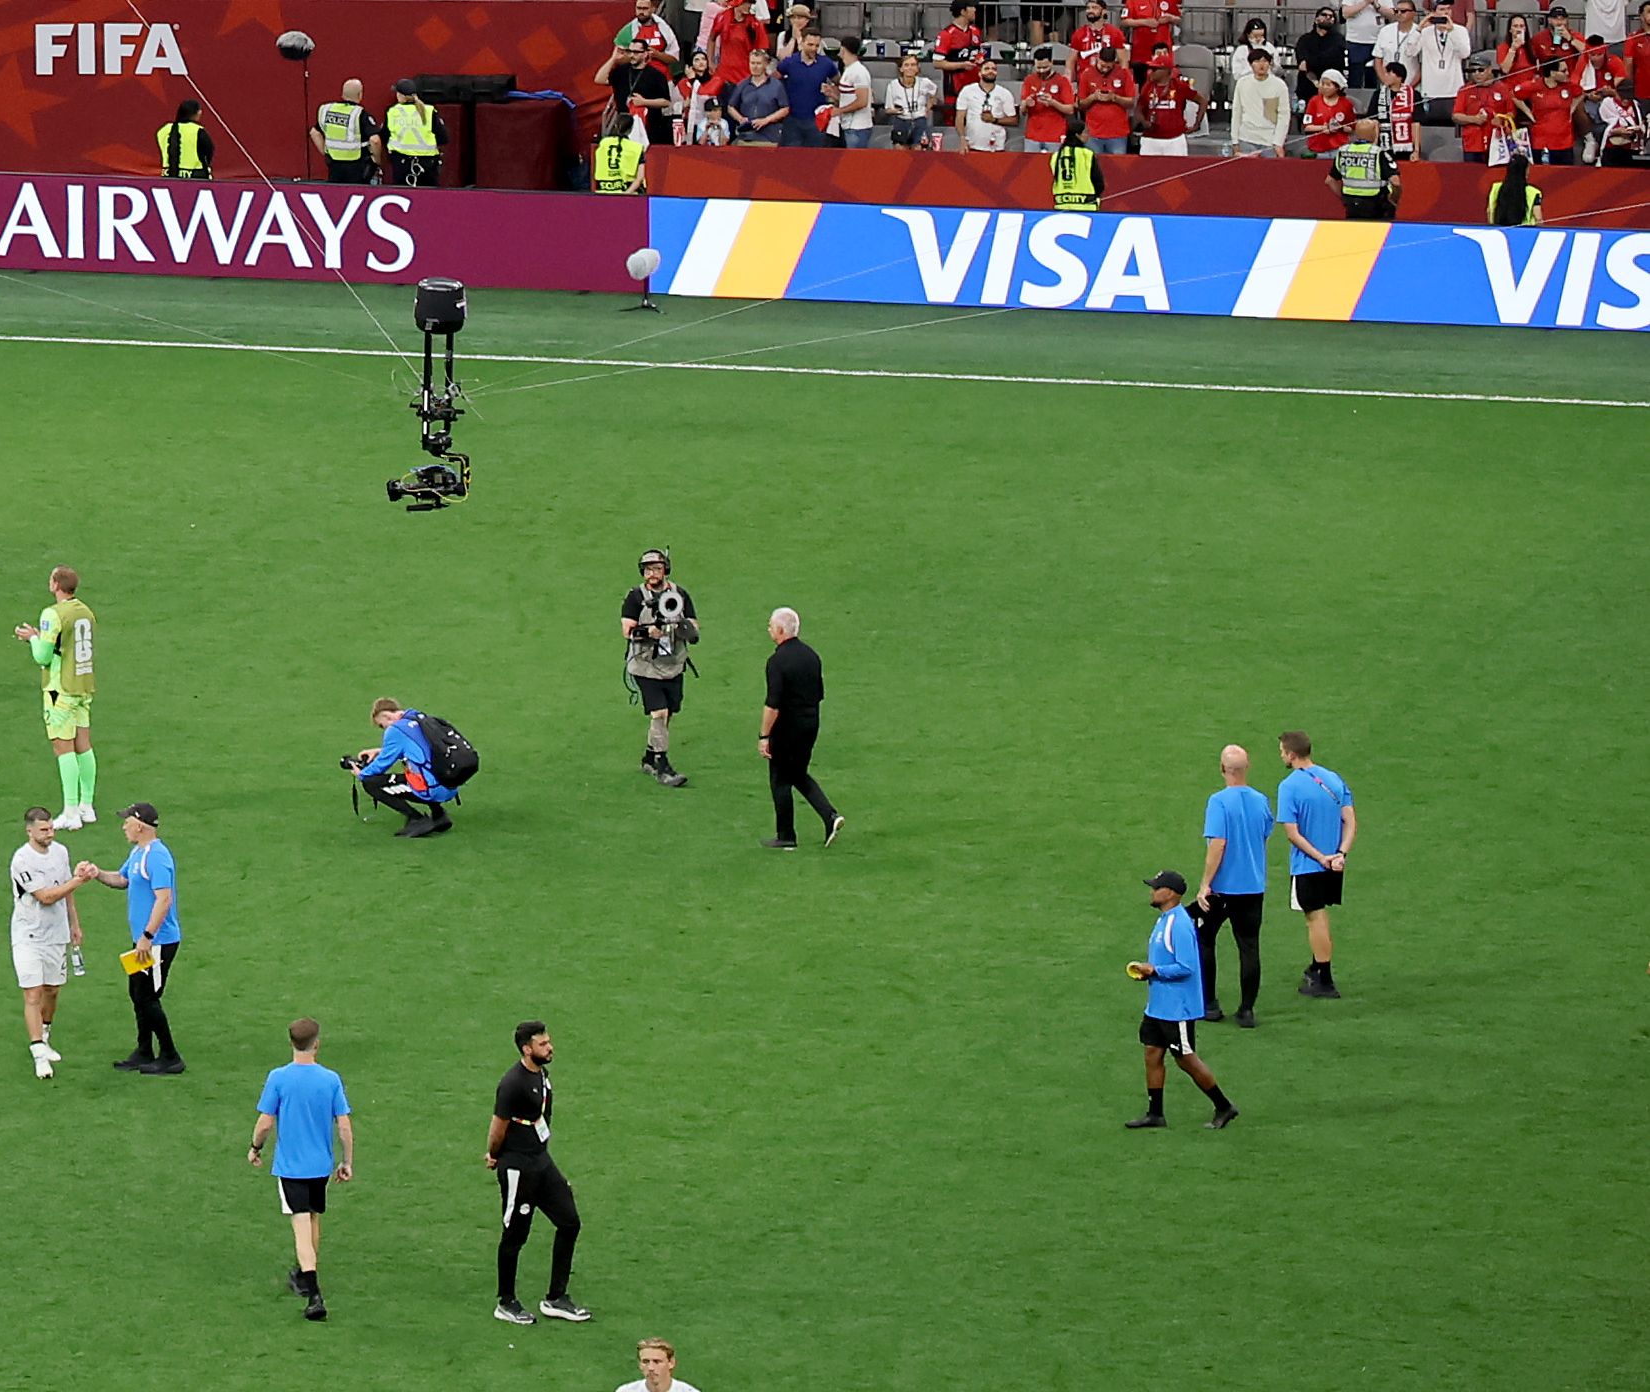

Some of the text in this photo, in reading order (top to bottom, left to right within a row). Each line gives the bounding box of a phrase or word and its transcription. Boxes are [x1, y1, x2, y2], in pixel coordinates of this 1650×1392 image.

[35, 23, 188, 76] FIFA
[325, 112, 349, 125] POLICE
[1338, 156, 1376, 170] POLICE
[881, 208, 1170, 311] VISA
[1451, 228, 1650, 330] VIS
